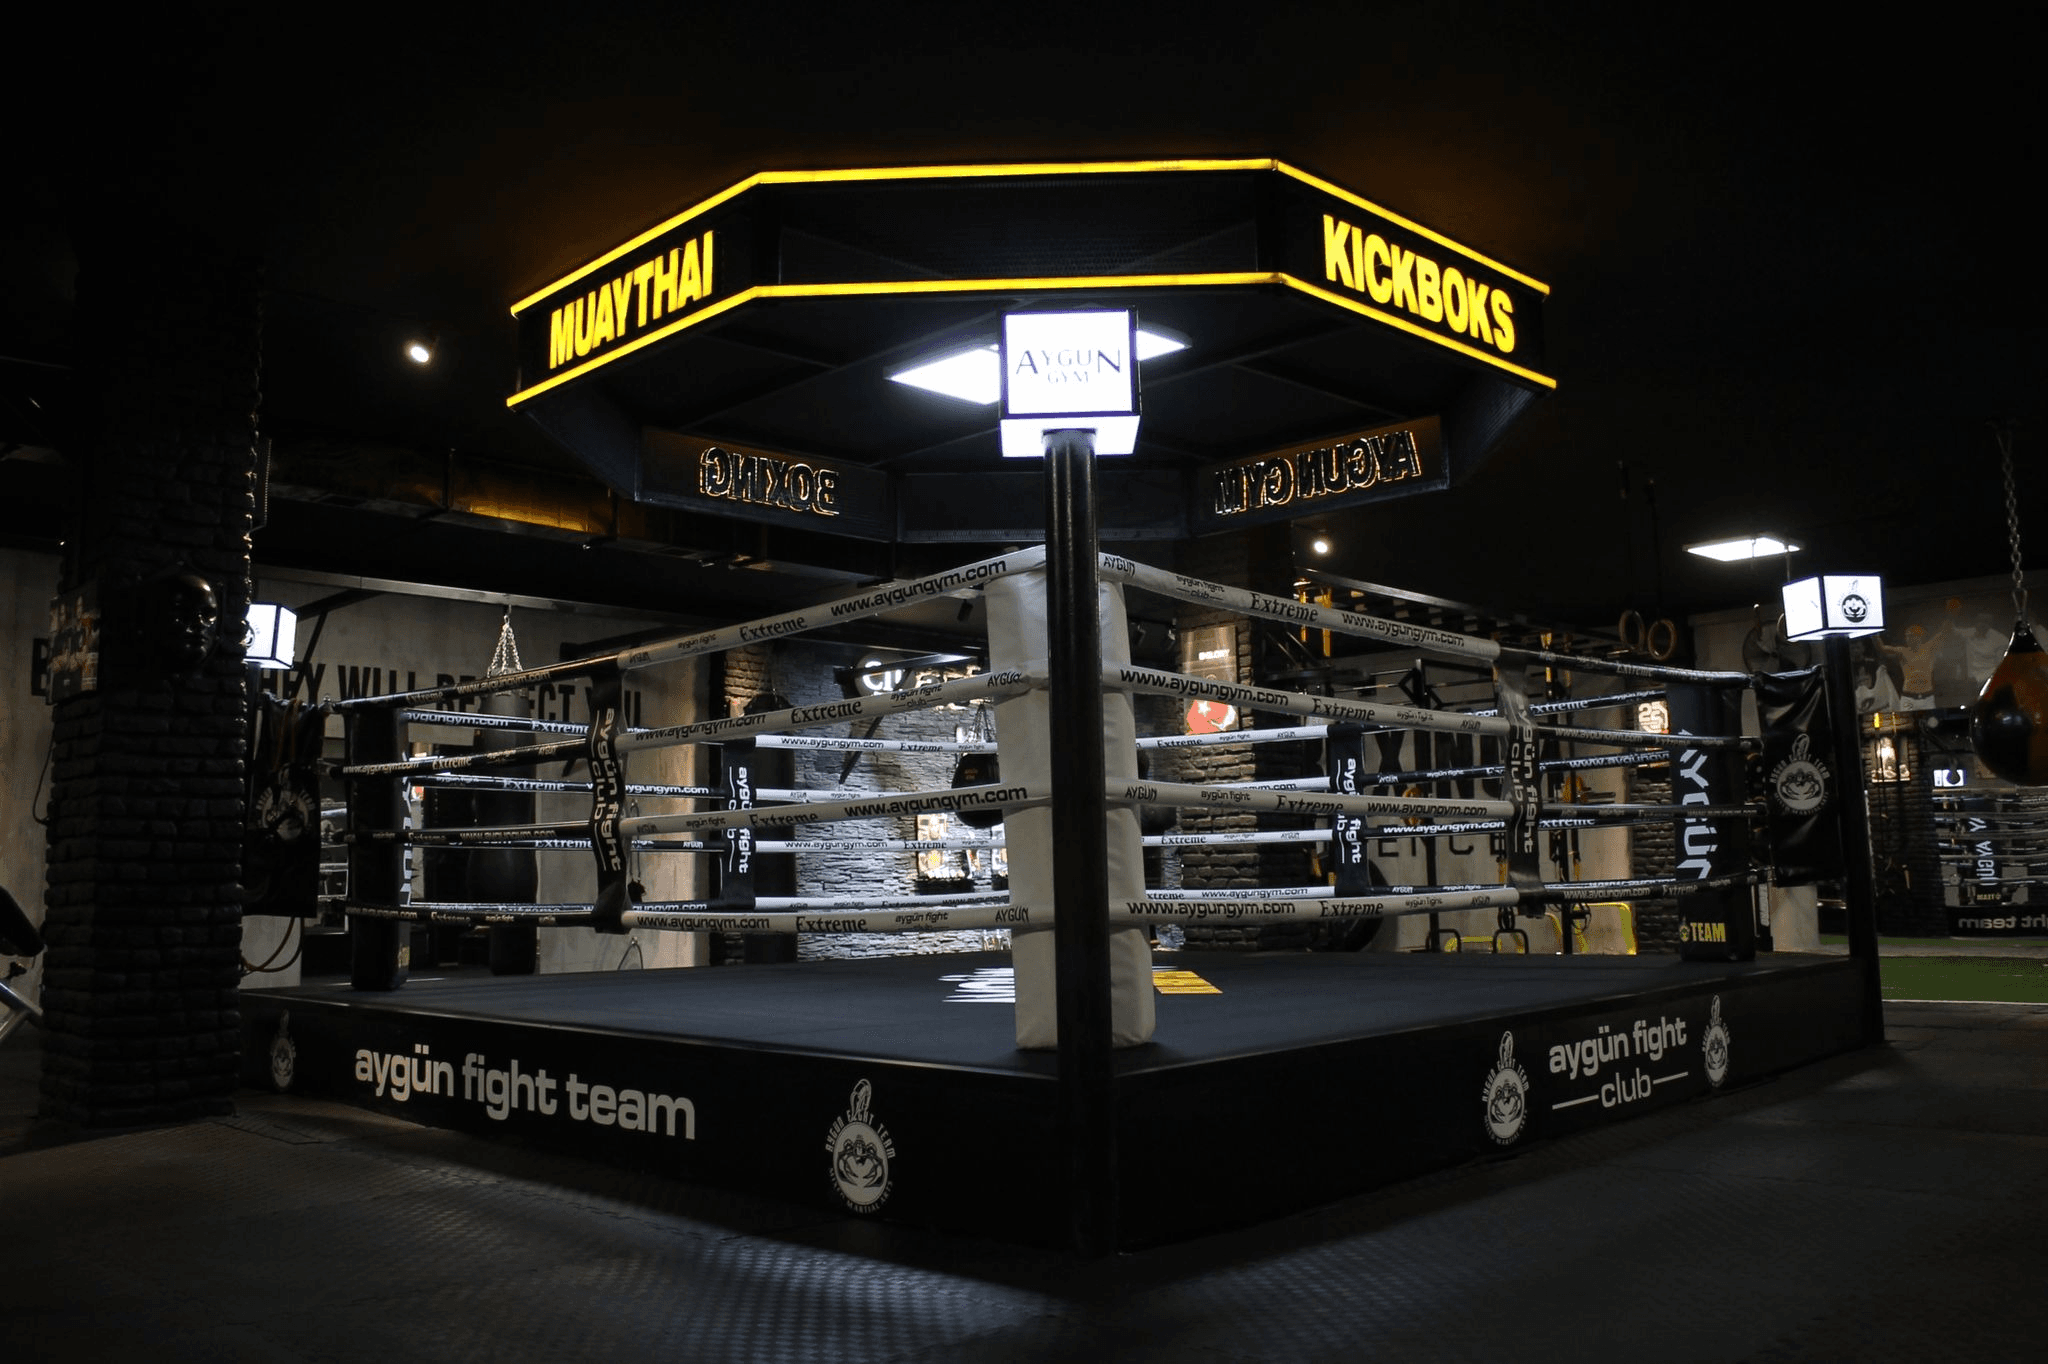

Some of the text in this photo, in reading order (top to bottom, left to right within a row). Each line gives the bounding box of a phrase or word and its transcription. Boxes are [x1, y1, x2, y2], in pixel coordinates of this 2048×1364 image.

[549, 229, 714, 370] MUAYTHAI
[1322, 213, 1517, 354] KICKBOKS
[1016, 349, 1121, 374] AYGUN
[739, 616, 808, 642] Extreme
[831, 560, 1007, 617] www.aygungym.com
[1250, 593, 1318, 622] Extreme
[1342, 611, 1465, 647] www.aygungym.com
[1121, 669, 1288, 706] www.aygungym.com
[1313, 697, 1375, 721] Extreme
[635, 715, 766, 741] www.aygungym.com
[791, 701, 862, 724] Extreme
[781, 737, 884, 750] www.aygungym.com
[900, 741, 943, 751] Extreme
[1157, 739, 1203, 748] Extreme
[592, 760, 606, 820] club
[598, 708, 622, 871] aygün fight
[1511, 743, 1524, 801] club
[738, 766, 752, 874] aygü fight
[749, 812, 818, 828] Extreme
[845, 786, 1027, 817] www.aygungym.com
[1229, 791, 1251, 803] fight
[1275, 794, 1344, 812] Extreme
[1367, 802, 1488, 816] www.aygungym.com
[1523, 785, 1538, 854] fight
[1538, 818, 1596, 829] xtreme
[785, 840, 887, 850] www.aygungym.com
[904, 841, 947, 850] Extreme
[1161, 834, 1207, 844] Extreme
[1346, 818, 1362, 864] fight
[1127, 902, 1296, 917] www.aygungym.com
[1320, 901, 1384, 917] Extreme
[1147, 887, 1308, 900] xtreme www.aygungym.com
[637, 915, 770, 931] www.aygungym.com
[796, 915, 868, 933] Extreme
[925, 911, 948, 924] fight
[1689, 922, 1727, 943] TEAM
[1549, 1025, 1629, 1080] aygün
[1632, 1016, 1687, 1061] fight
[355, 1043, 454, 1101] aygün
[462, 1052, 557, 1121] fight
[565, 1073, 696, 1140] team
[1600, 1067, 1652, 1108] club
